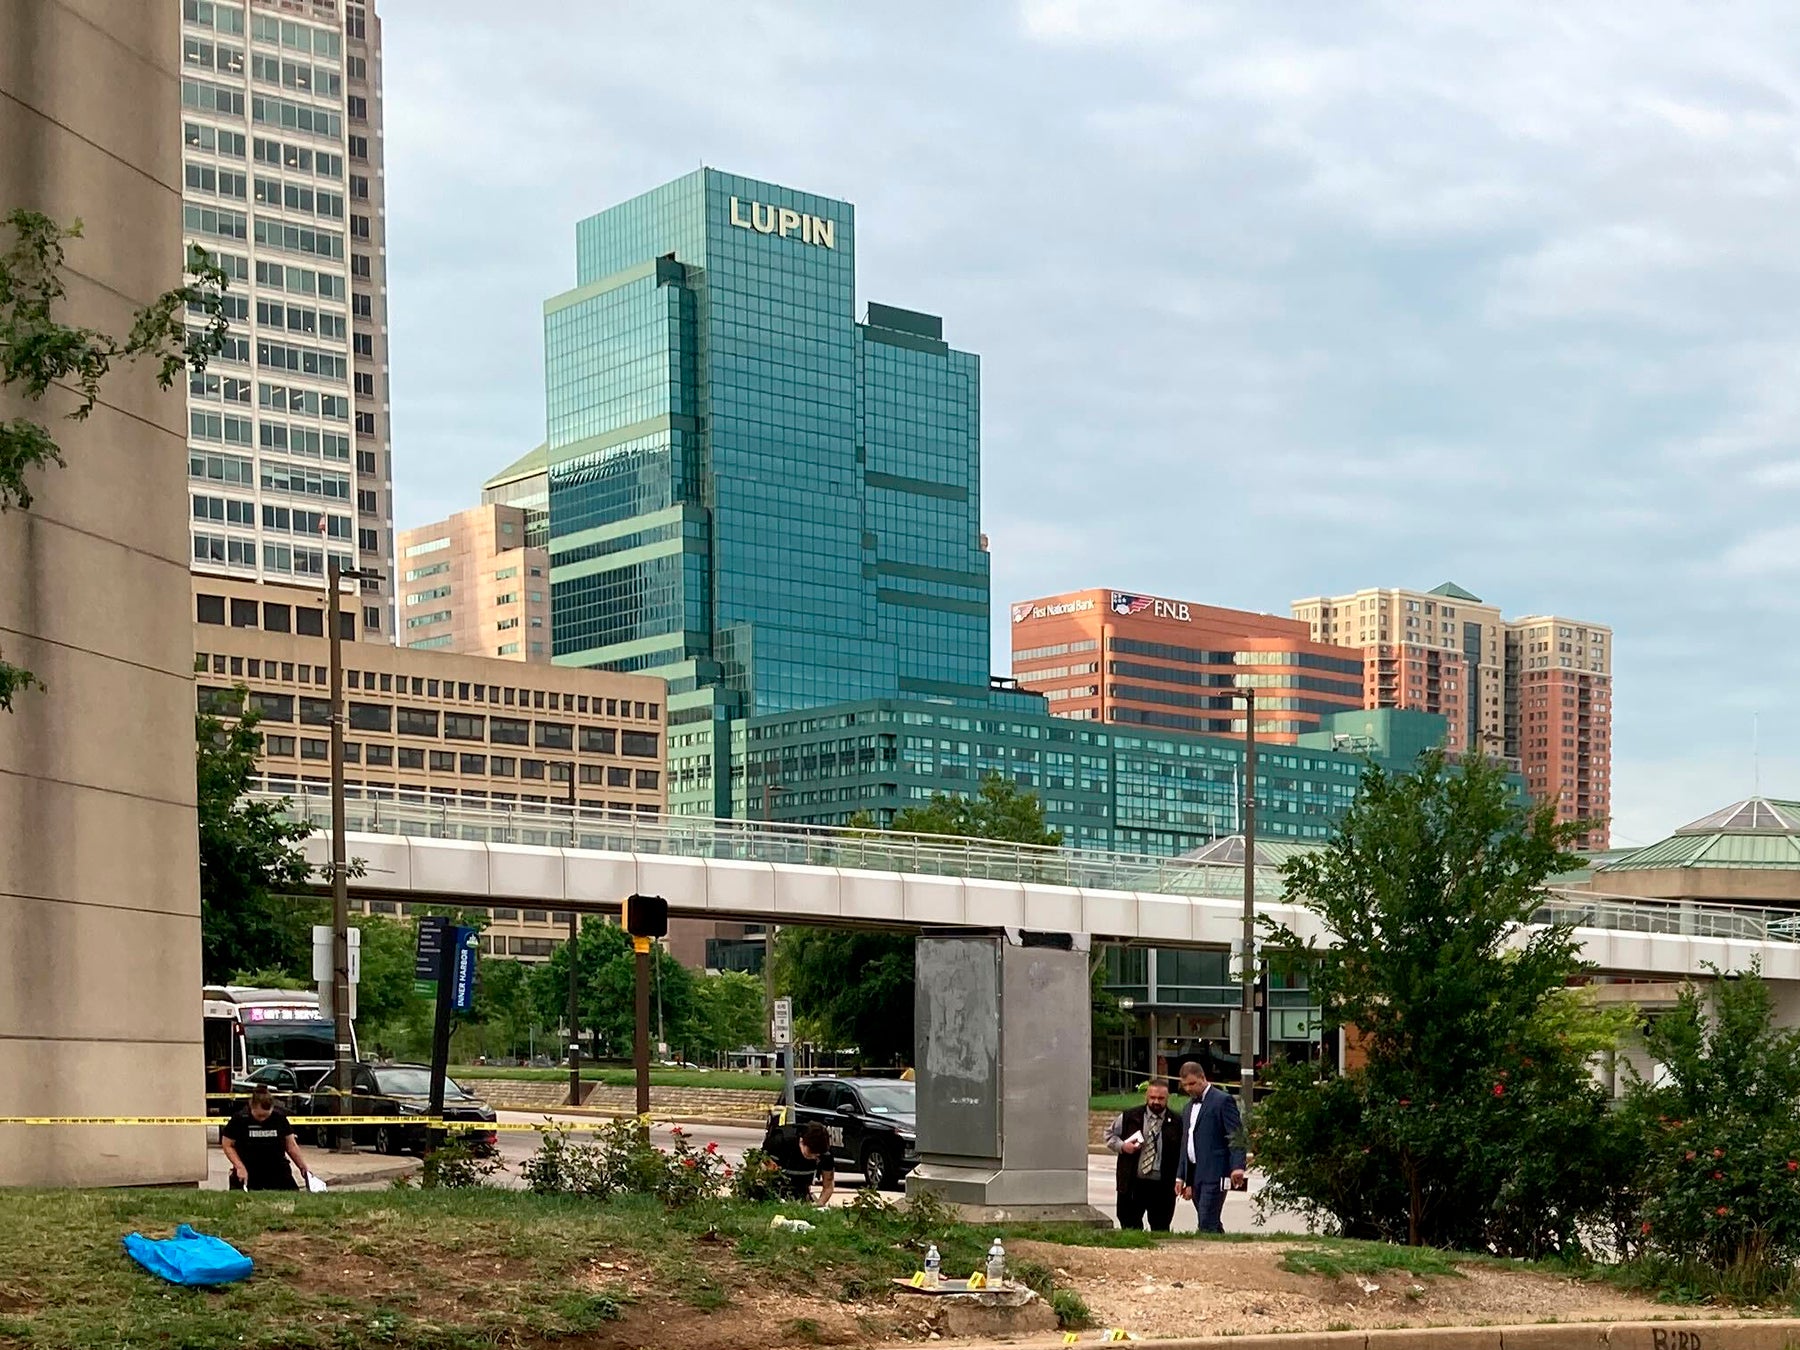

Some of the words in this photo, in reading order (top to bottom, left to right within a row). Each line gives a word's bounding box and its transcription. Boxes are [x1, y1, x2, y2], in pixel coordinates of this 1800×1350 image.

[729, 196, 834, 249] LUPIN
[1032, 606, 1046, 619] First
[1047, 600, 1076, 617] National
[1076, 598, 1095, 611] Bank
[1154, 599, 1192, 622] F.N.B.
[460, 949, 468, 982] HARBOR
[457, 983, 466, 1007] INNER
